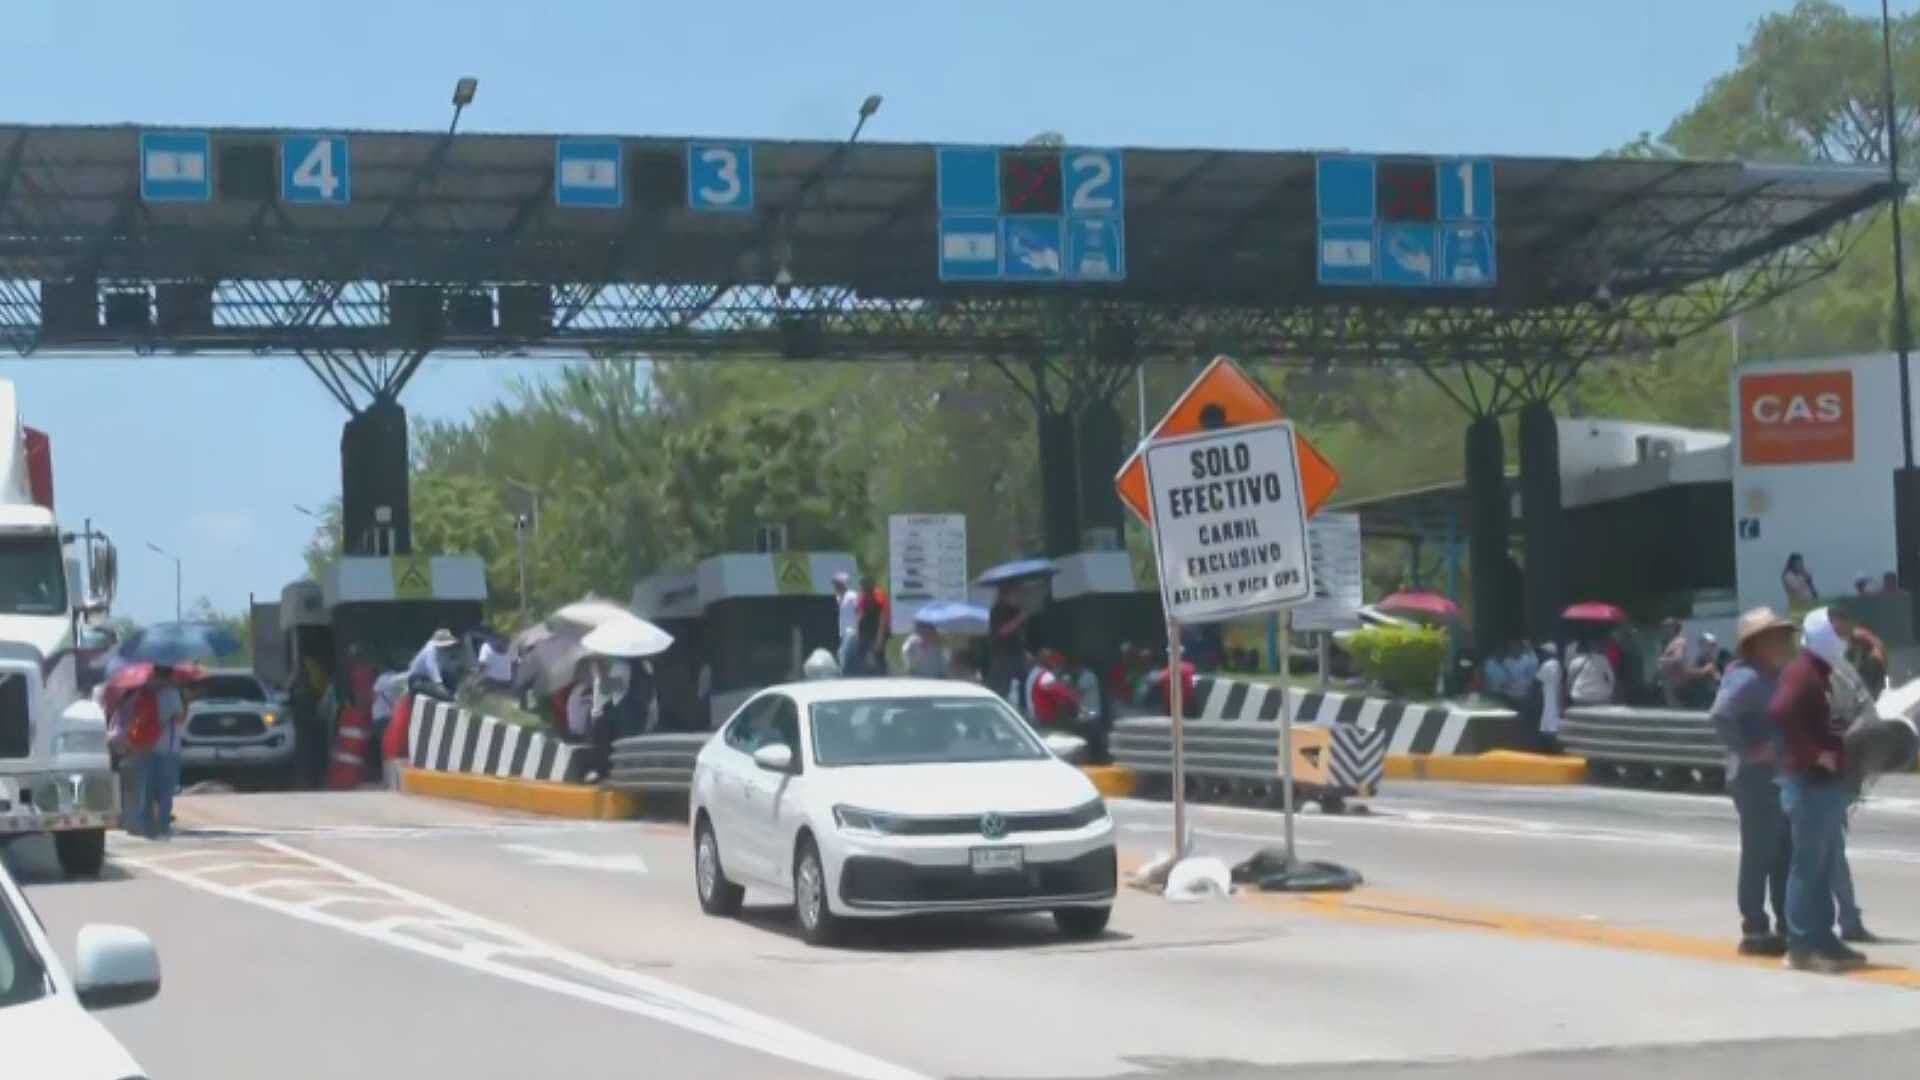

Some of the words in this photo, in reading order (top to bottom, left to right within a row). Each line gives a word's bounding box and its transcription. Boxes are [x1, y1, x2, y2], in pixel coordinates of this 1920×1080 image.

[293, 139, 339, 196] 4
[700, 150, 741, 204] 3
[1072, 157, 1113, 209] 2
[1457, 162, 1475, 218] 1
[1752, 393, 1842, 424] CAS
[1190, 442, 1250, 479] SOLO
[1168, 473, 1281, 519] EFECTIVO
[1199, 518, 1260, 546] CARRIL
[1187, 543, 1281, 577] EXCLUSIVO
